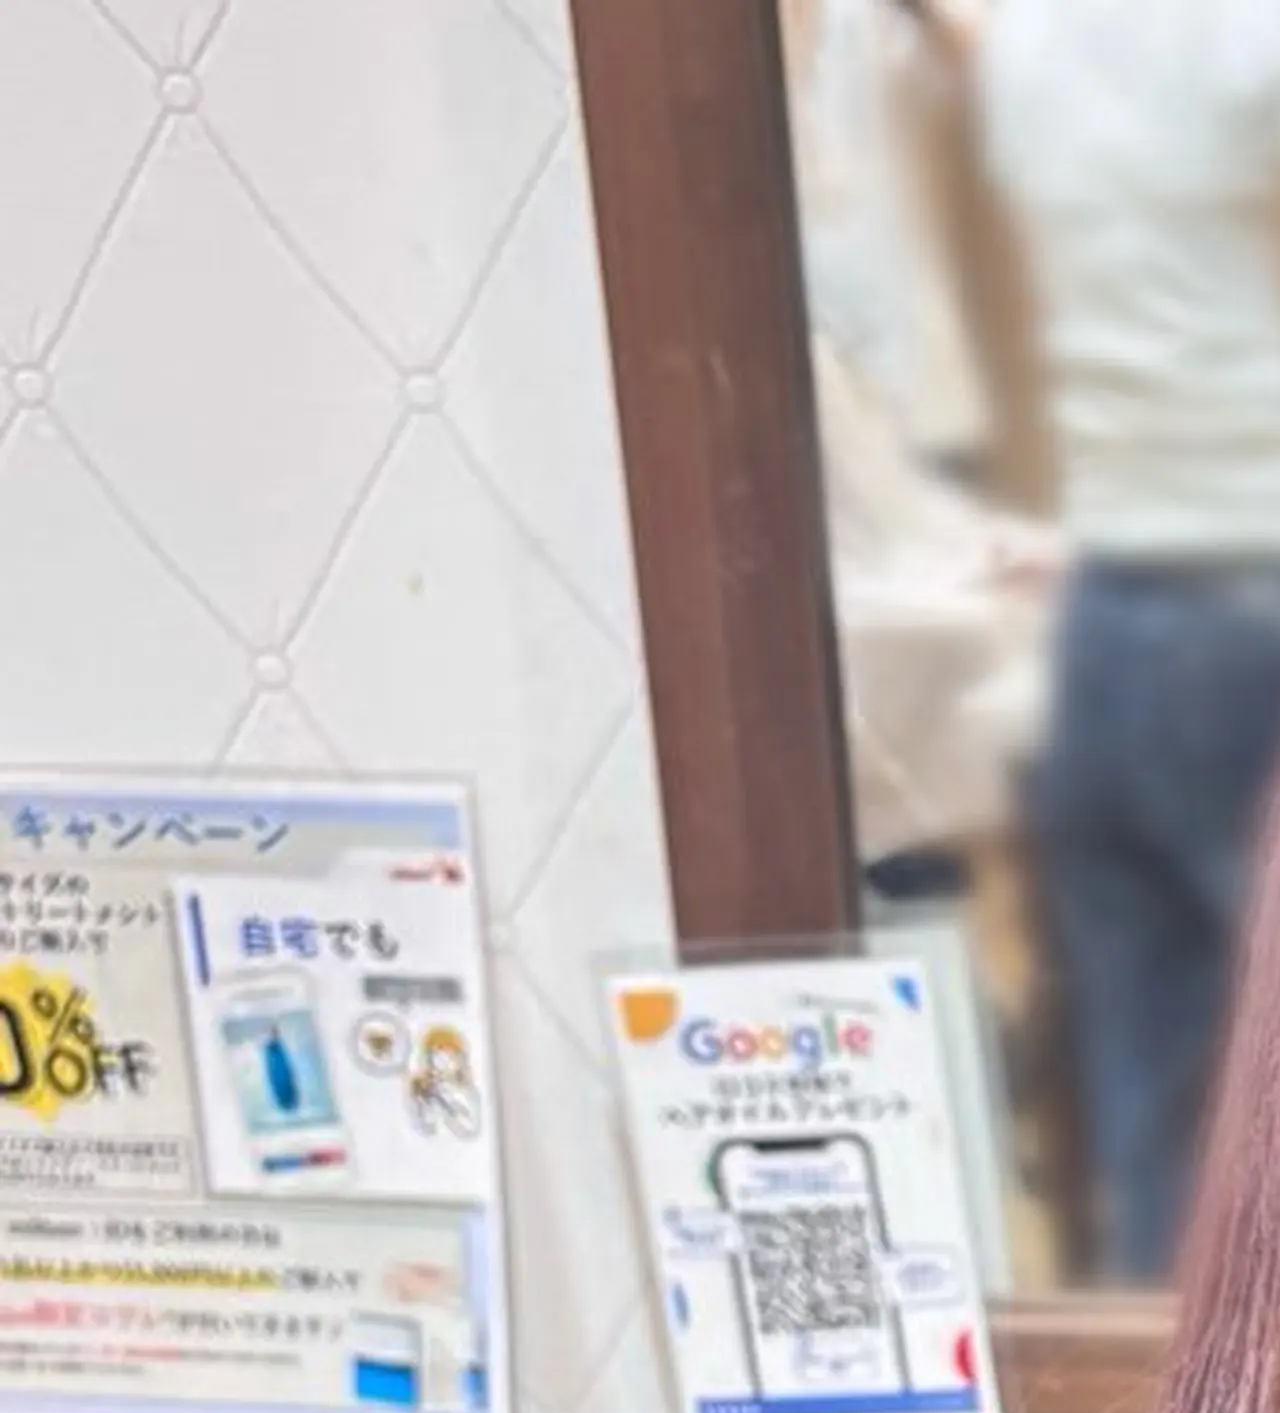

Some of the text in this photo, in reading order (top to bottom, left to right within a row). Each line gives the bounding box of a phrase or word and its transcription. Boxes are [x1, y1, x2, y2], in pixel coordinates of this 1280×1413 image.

[13, 804, 291, 853] キャンペーン
[239, 913, 400, 961] 自宅でも
[679, 1013, 875, 1071] Google
[47, 1041, 155, 1099] OFF
